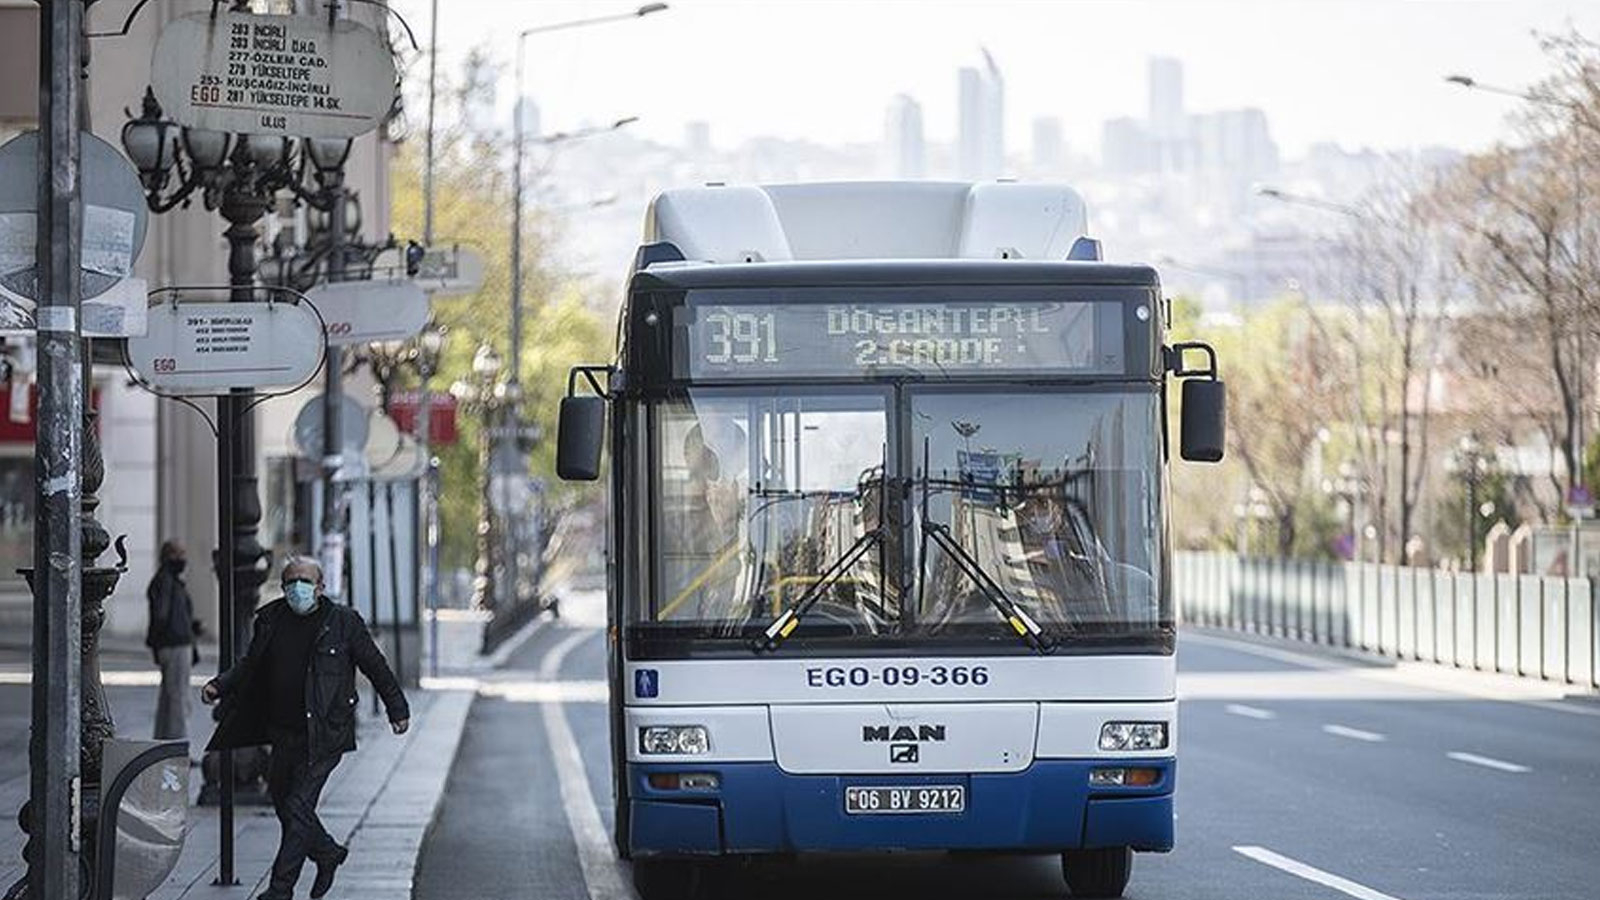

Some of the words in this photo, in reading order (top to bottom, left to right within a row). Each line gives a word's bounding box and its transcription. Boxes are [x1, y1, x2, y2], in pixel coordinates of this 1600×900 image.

[191, 85, 220, 103] EGO
[249, 90, 309, 108] YÜKSELTEPE
[261, 115, 287, 130] ULUS
[706, 311, 779, 364] 391
[153, 358, 176, 372] EGO
[806, 666, 990, 688] EGO-09-366
[862, 724, 946, 742] MAN
[858, 790, 879, 809] 06
[919, 789, 960, 809] 9212
